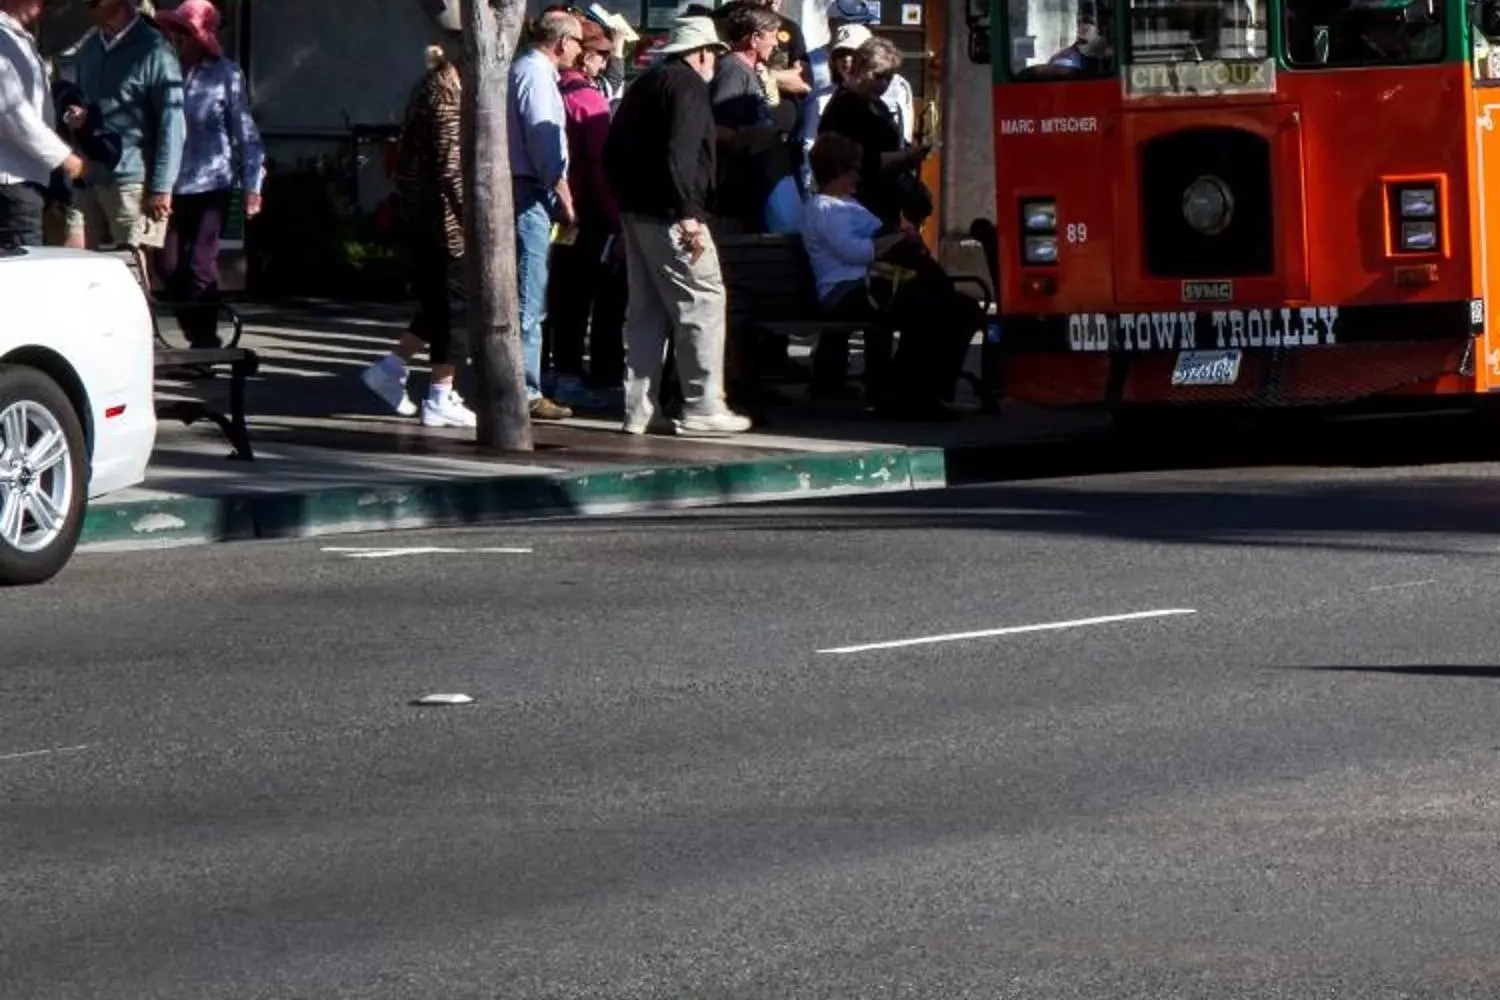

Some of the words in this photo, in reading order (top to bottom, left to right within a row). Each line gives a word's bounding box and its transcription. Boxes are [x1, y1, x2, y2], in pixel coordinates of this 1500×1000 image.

[1131, 64, 1186, 88] CITY
[1200, 62, 1265, 85] TOUR
[1001, 118, 1034, 134] MARC
[1041, 117, 1097, 133] MITSCHER
[1067, 223, 1088, 243] 89
[1069, 313, 1109, 351] OLD
[1120, 311, 1197, 350] TOWN
[1212, 305, 1339, 347] TROLLEY
